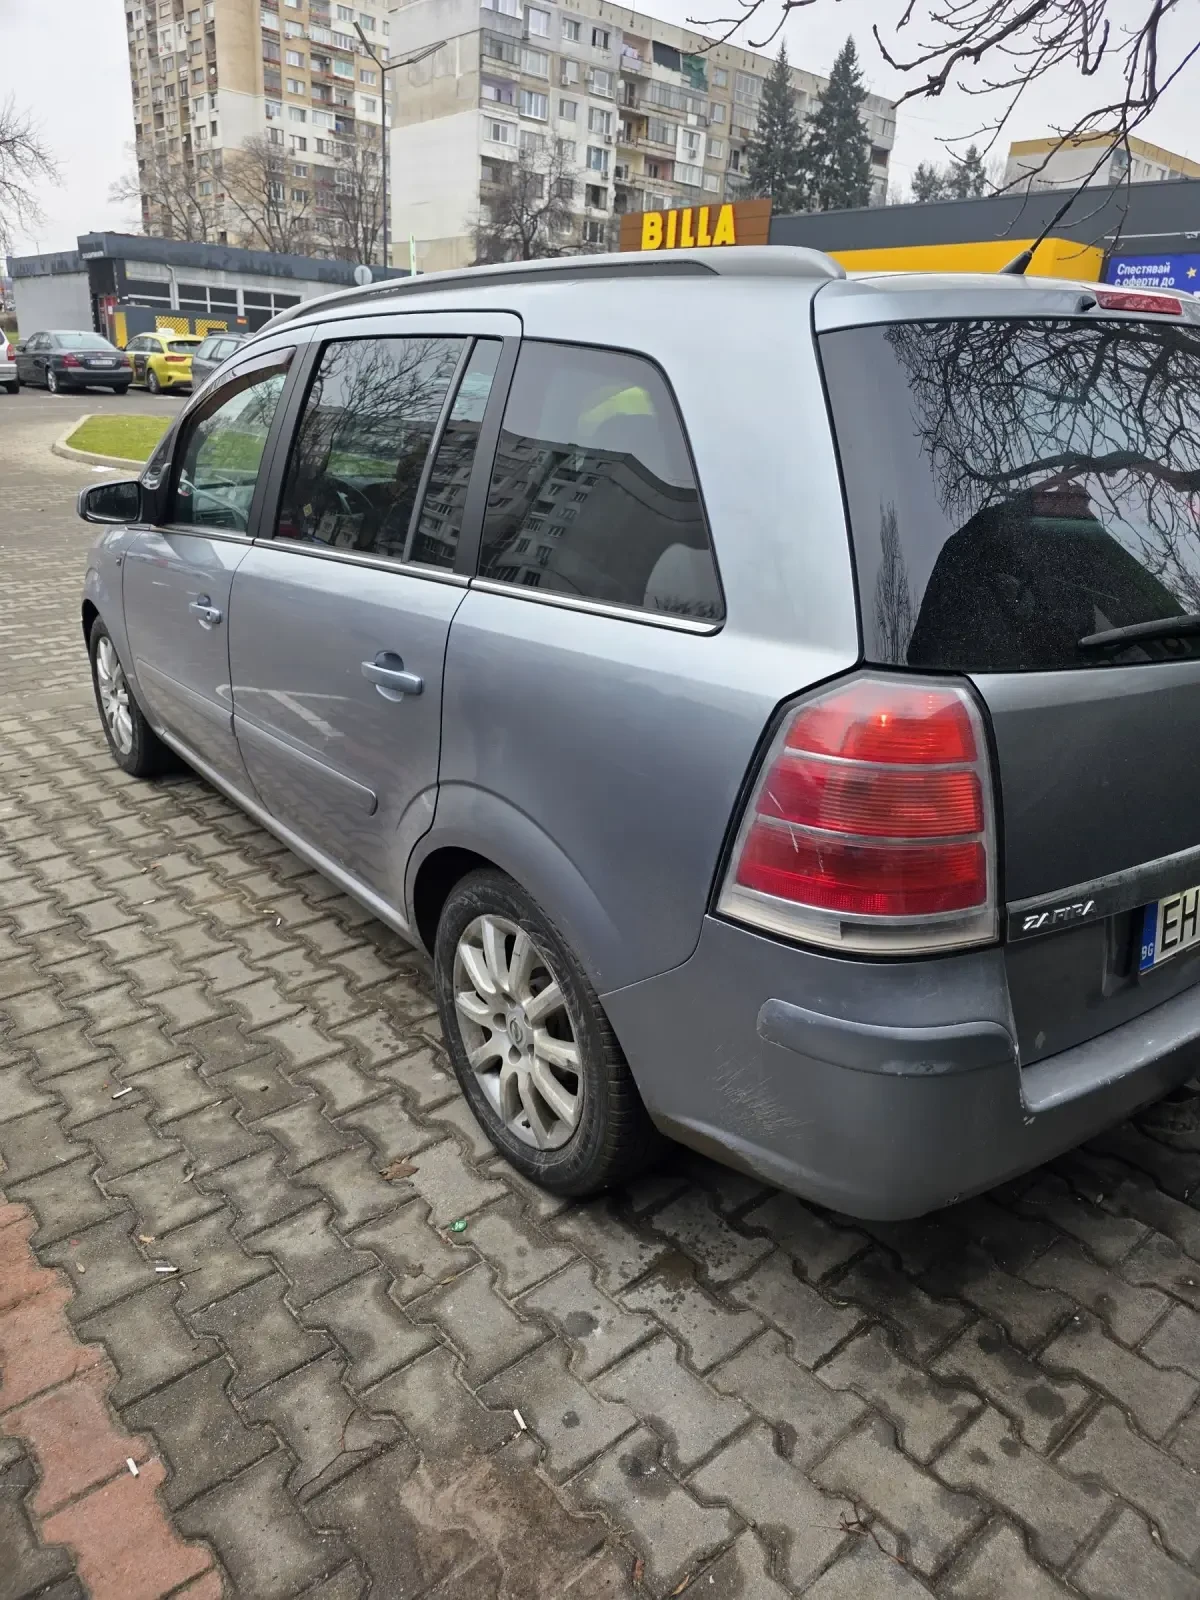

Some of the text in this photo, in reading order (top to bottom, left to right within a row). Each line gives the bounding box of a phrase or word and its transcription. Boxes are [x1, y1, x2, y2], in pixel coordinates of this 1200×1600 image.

[641, 204, 735, 250] BILLA
[1117, 262, 1171, 275] Спестявай
[1114, 275, 1175, 288] с оферти до
[1022, 900, 1096, 931] ZAFIRA
[1160, 889, 1200, 953] EH
[1141, 943, 1154, 960] BG
